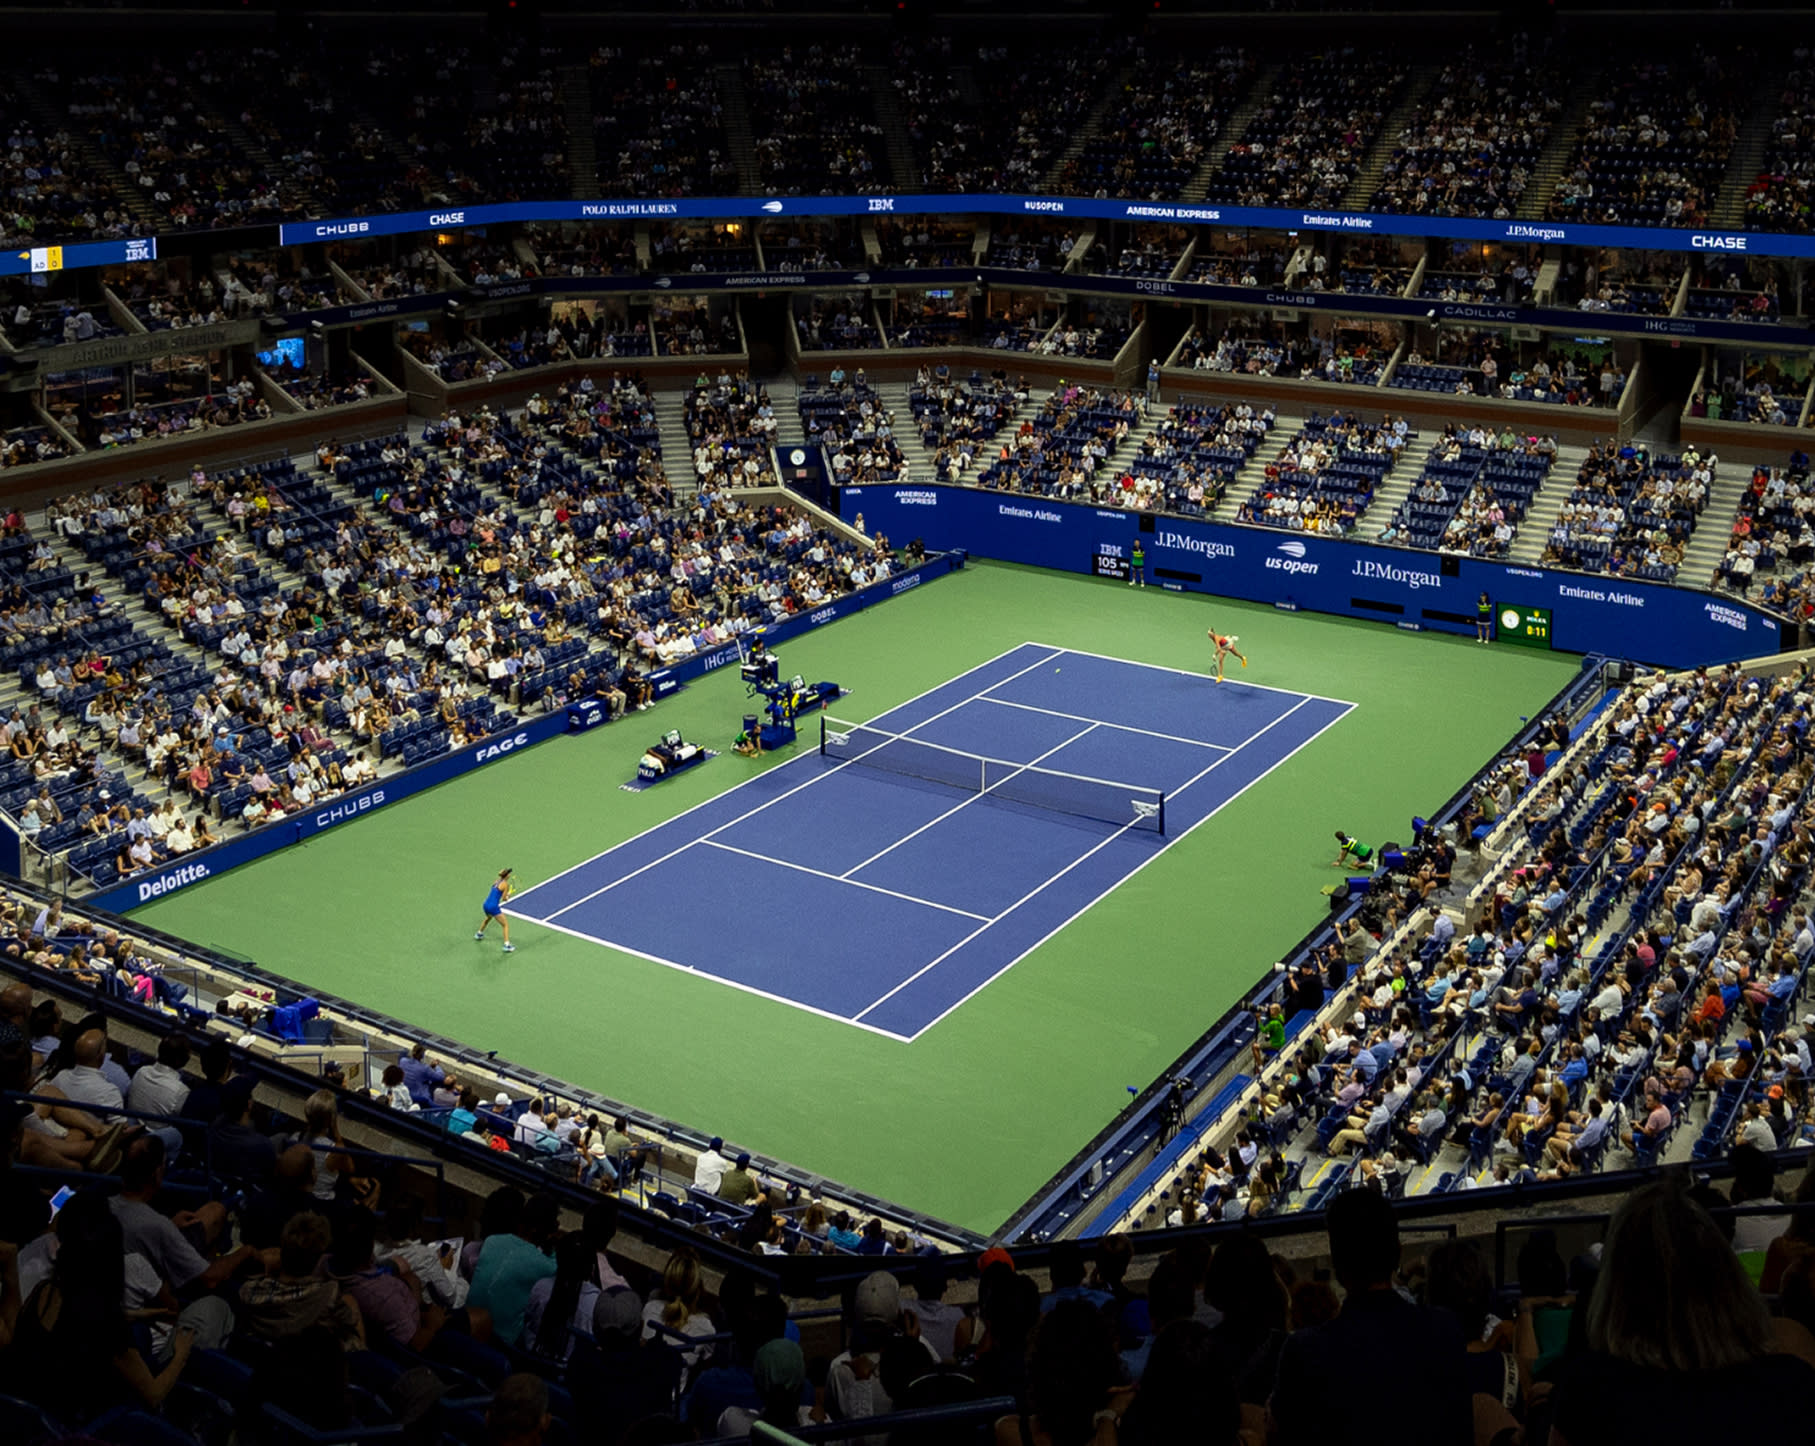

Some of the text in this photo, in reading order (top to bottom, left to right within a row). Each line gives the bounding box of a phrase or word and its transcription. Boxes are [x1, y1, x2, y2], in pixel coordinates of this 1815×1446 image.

[582, 204, 677, 215] POLO RALPH LAUREN
[868, 199, 894, 211] IBM
[1127, 206, 1220, 219] AMERICAN EXPRESS
[430, 212, 464, 226] CHASE
[1303, 214, 1373, 228] Emirates Airline
[316, 222, 369, 236] CHUBB
[1506, 225, 1565, 240] J.P.Morgan
[1691, 235, 1747, 250] CHASE
[125, 247, 149, 262] IBM
[725, 276, 806, 286] AMERICAN EXPRESS
[1136, 281, 1176, 292] DOBEL
[1266, 293, 1316, 305] CHUBB
[1443, 306, 1518, 320] CADILLAC
[1645, 319, 1668, 331] IHG
[900, 497, 937, 505] EXPRESS
[999, 504, 1062, 523] Emirates Airline
[1100, 543, 1122, 557] IBM
[1154, 531, 1236, 559] J.P.Morgan
[1098, 556, 1117, 569] 105
[1265, 557, 1319, 575] us open
[1351, 560, 1441, 589] J.P.Morgan
[892, 574, 920, 591] moderna
[1559, 584, 1645, 607] Emirates Airline
[811, 607, 836, 623] DOBEL
[1704, 602, 1747, 622] AMERICAN
[1710, 612, 1747, 631] EXPRESS
[704, 651, 725, 671] IHG
[316, 790, 385, 827] CHUBB
[138, 864, 211, 901] Deloitte.
